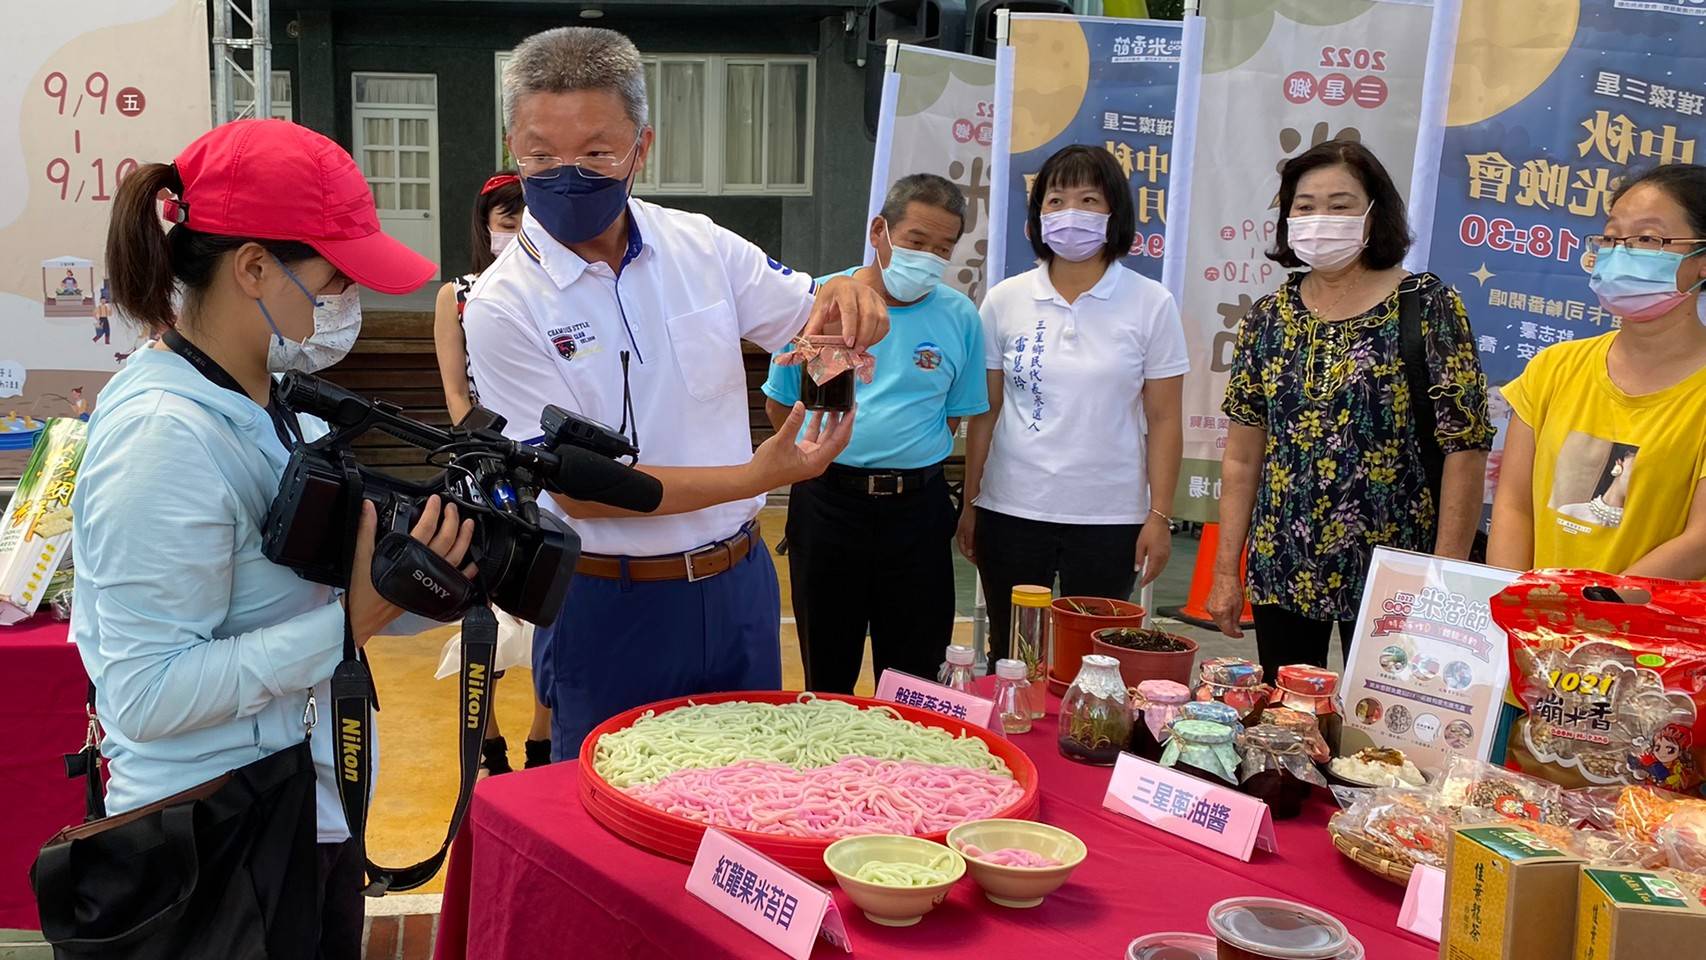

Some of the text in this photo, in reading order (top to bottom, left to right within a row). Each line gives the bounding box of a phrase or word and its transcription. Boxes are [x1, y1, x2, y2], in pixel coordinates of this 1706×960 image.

[44, 71, 109, 116] 9/9
[412, 567, 450, 600] SONY
[466, 662, 486, 730] Nikon
[1547, 670, 1615, 697] 1021
[341, 717, 361, 783] Nikon
[711, 854, 799, 931] 紅龍果米苔目
